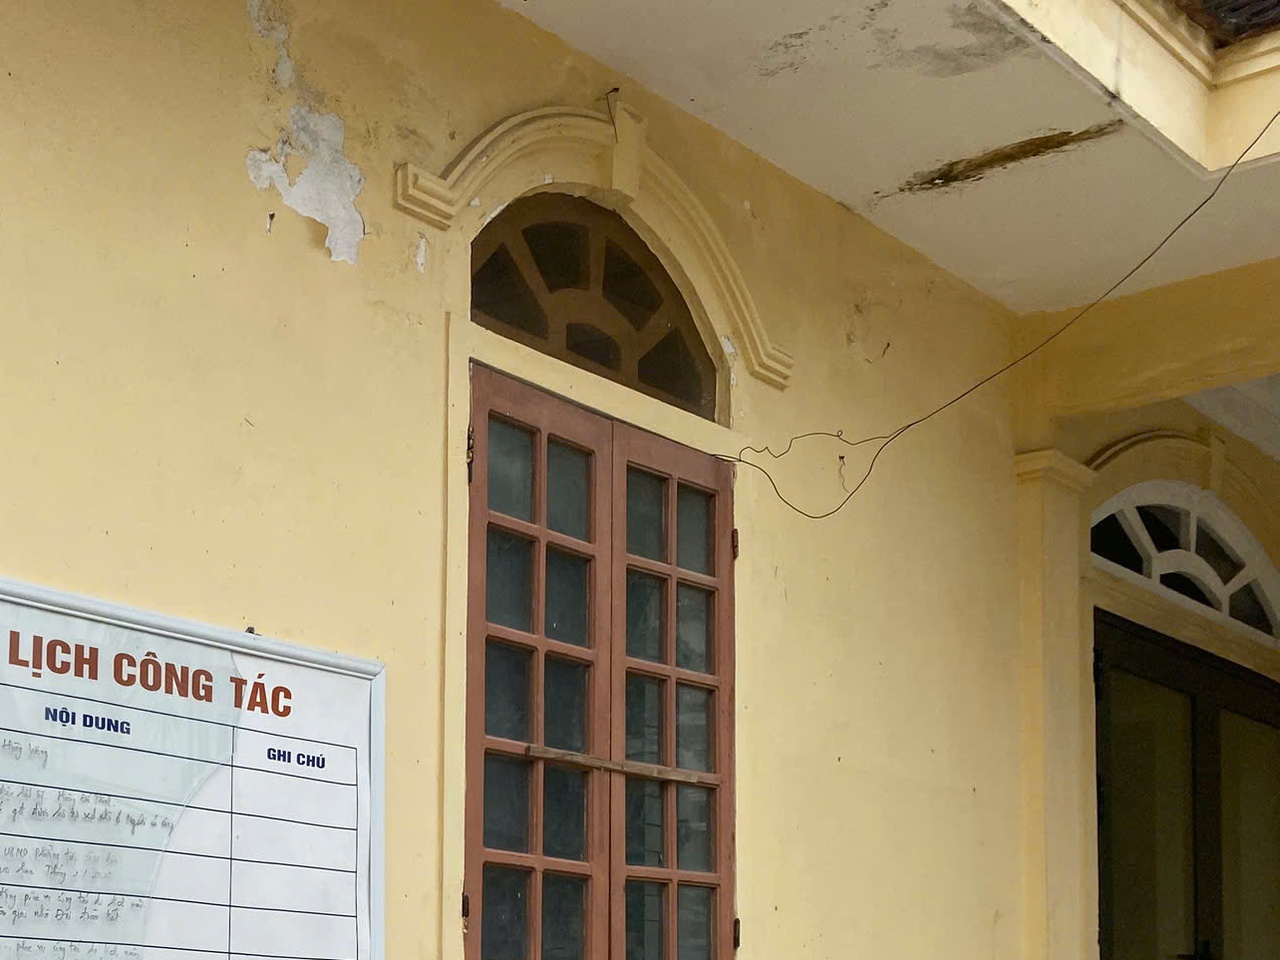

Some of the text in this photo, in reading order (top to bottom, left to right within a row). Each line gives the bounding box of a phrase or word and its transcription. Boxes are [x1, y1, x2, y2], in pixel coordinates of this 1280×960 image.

[8, 630, 292, 718] LỊCH CÔNG TÁC
[45, 707, 131, 735] NỘI DUNG
[267, 748, 325, 769] GHI CHÚ
